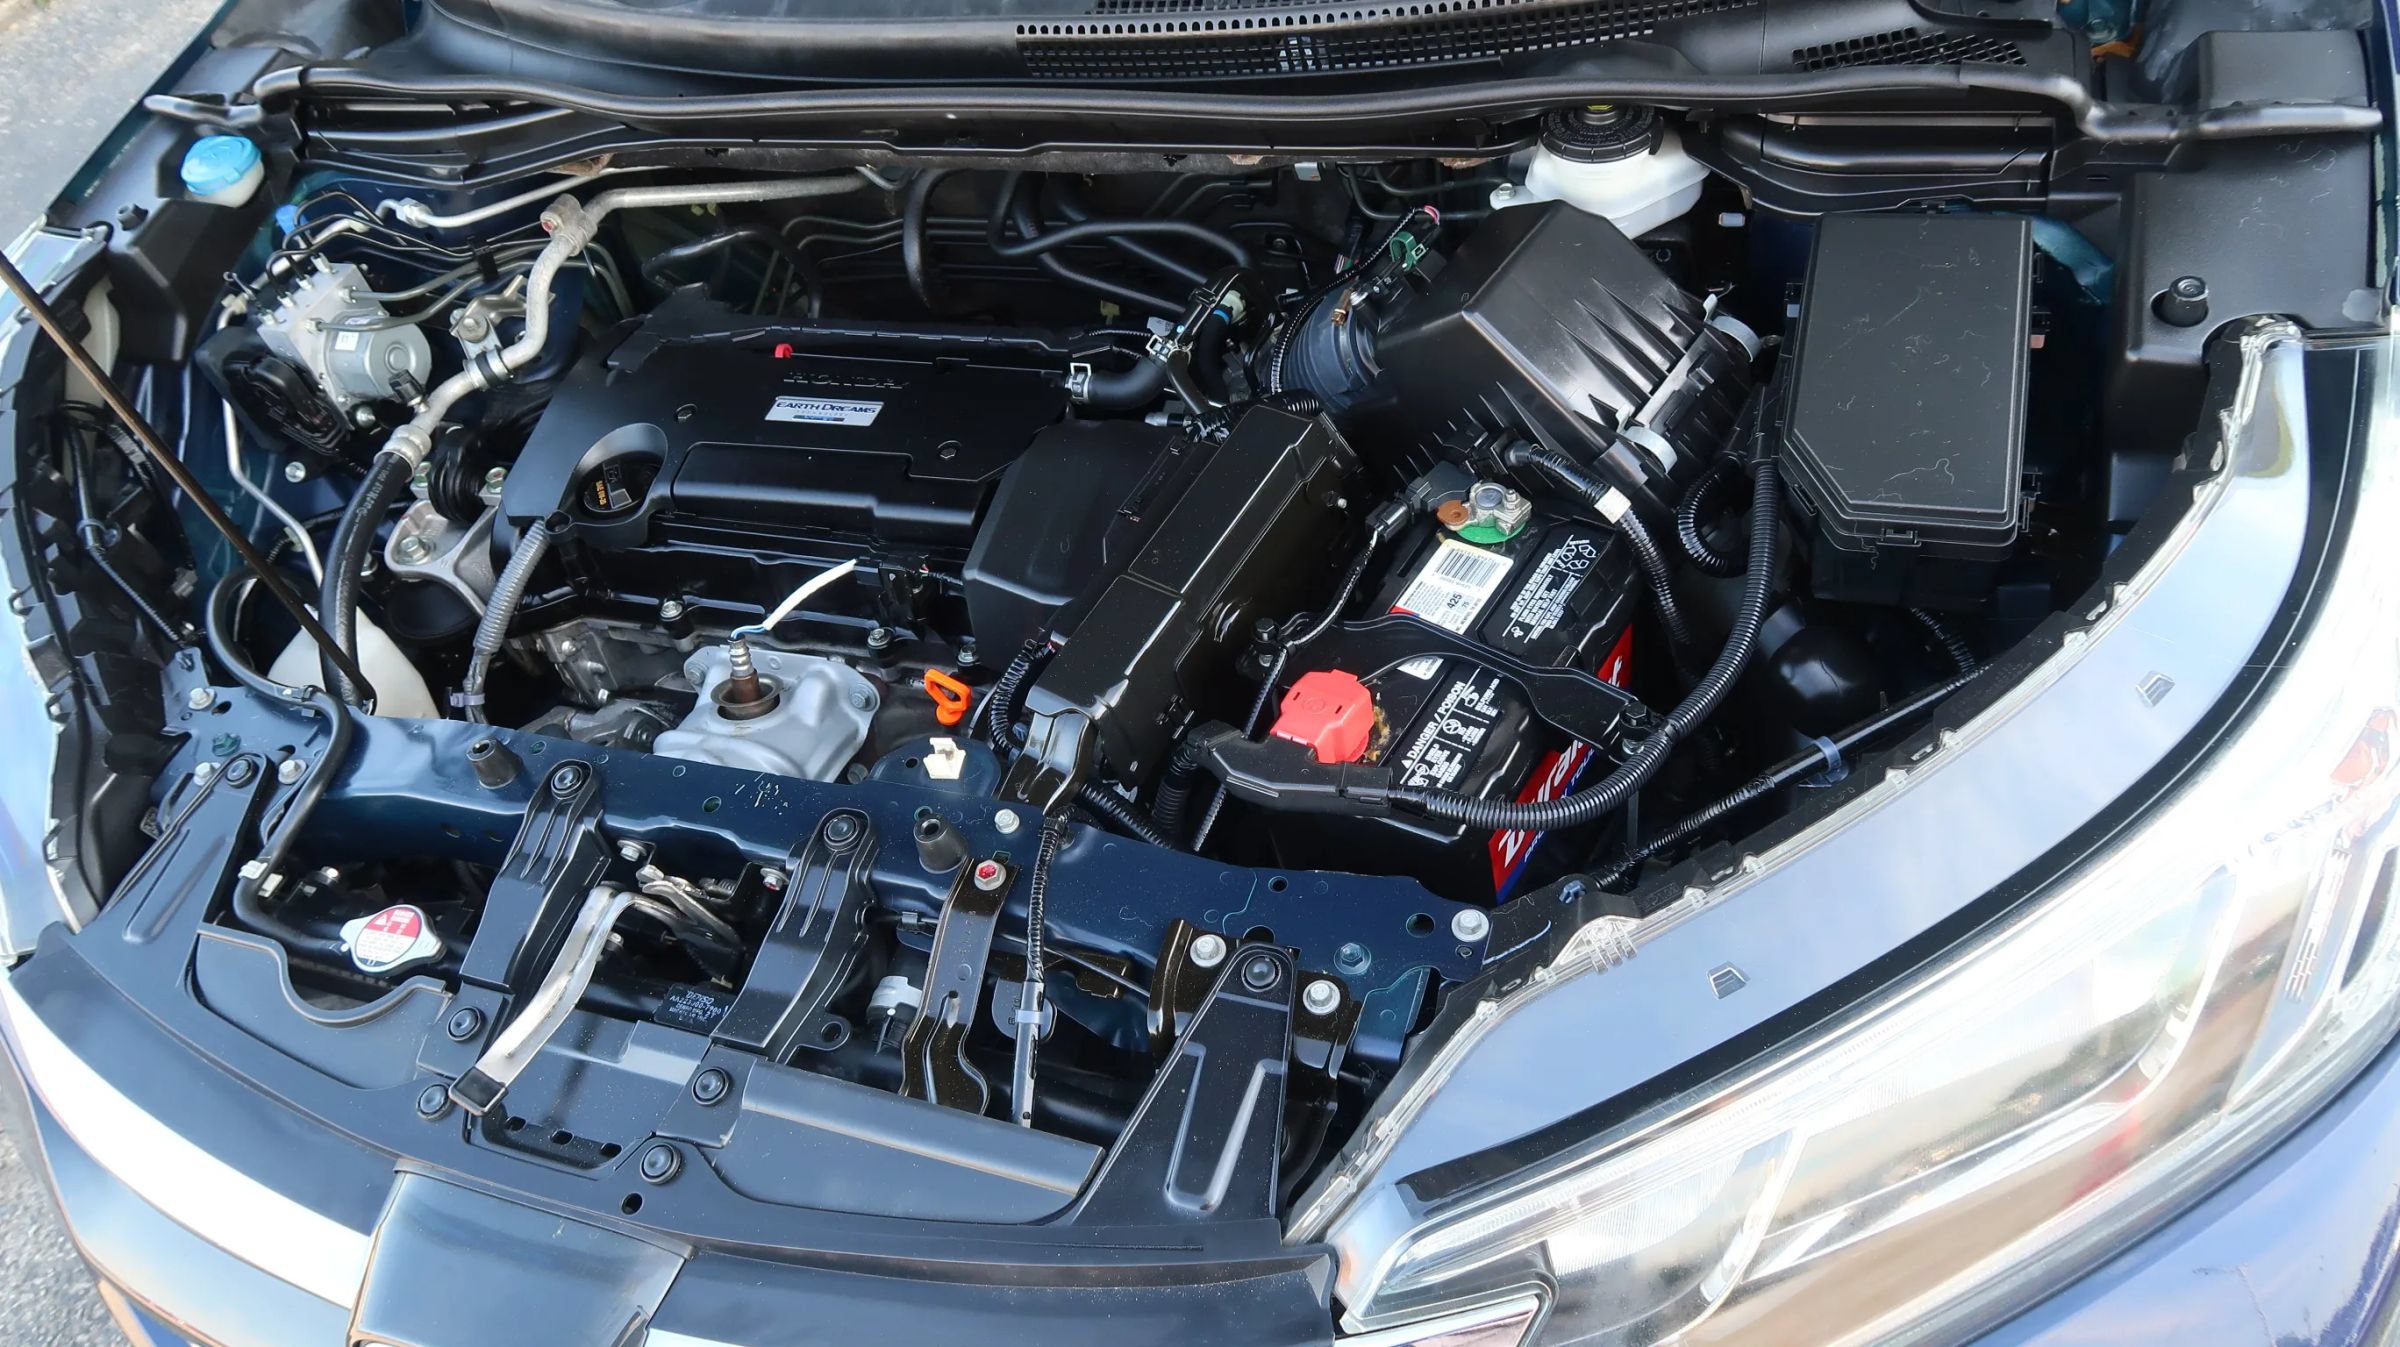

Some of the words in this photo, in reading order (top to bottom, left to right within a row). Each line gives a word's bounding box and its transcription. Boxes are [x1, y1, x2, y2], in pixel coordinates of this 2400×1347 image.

[776, 401, 820, 411] EARTH
[821, 404, 877, 413] DREAMS
[1447, 593, 1463, 609] 425
[1406, 720, 1439, 760] DANGER
[1437, 680, 1466, 715] POISON
